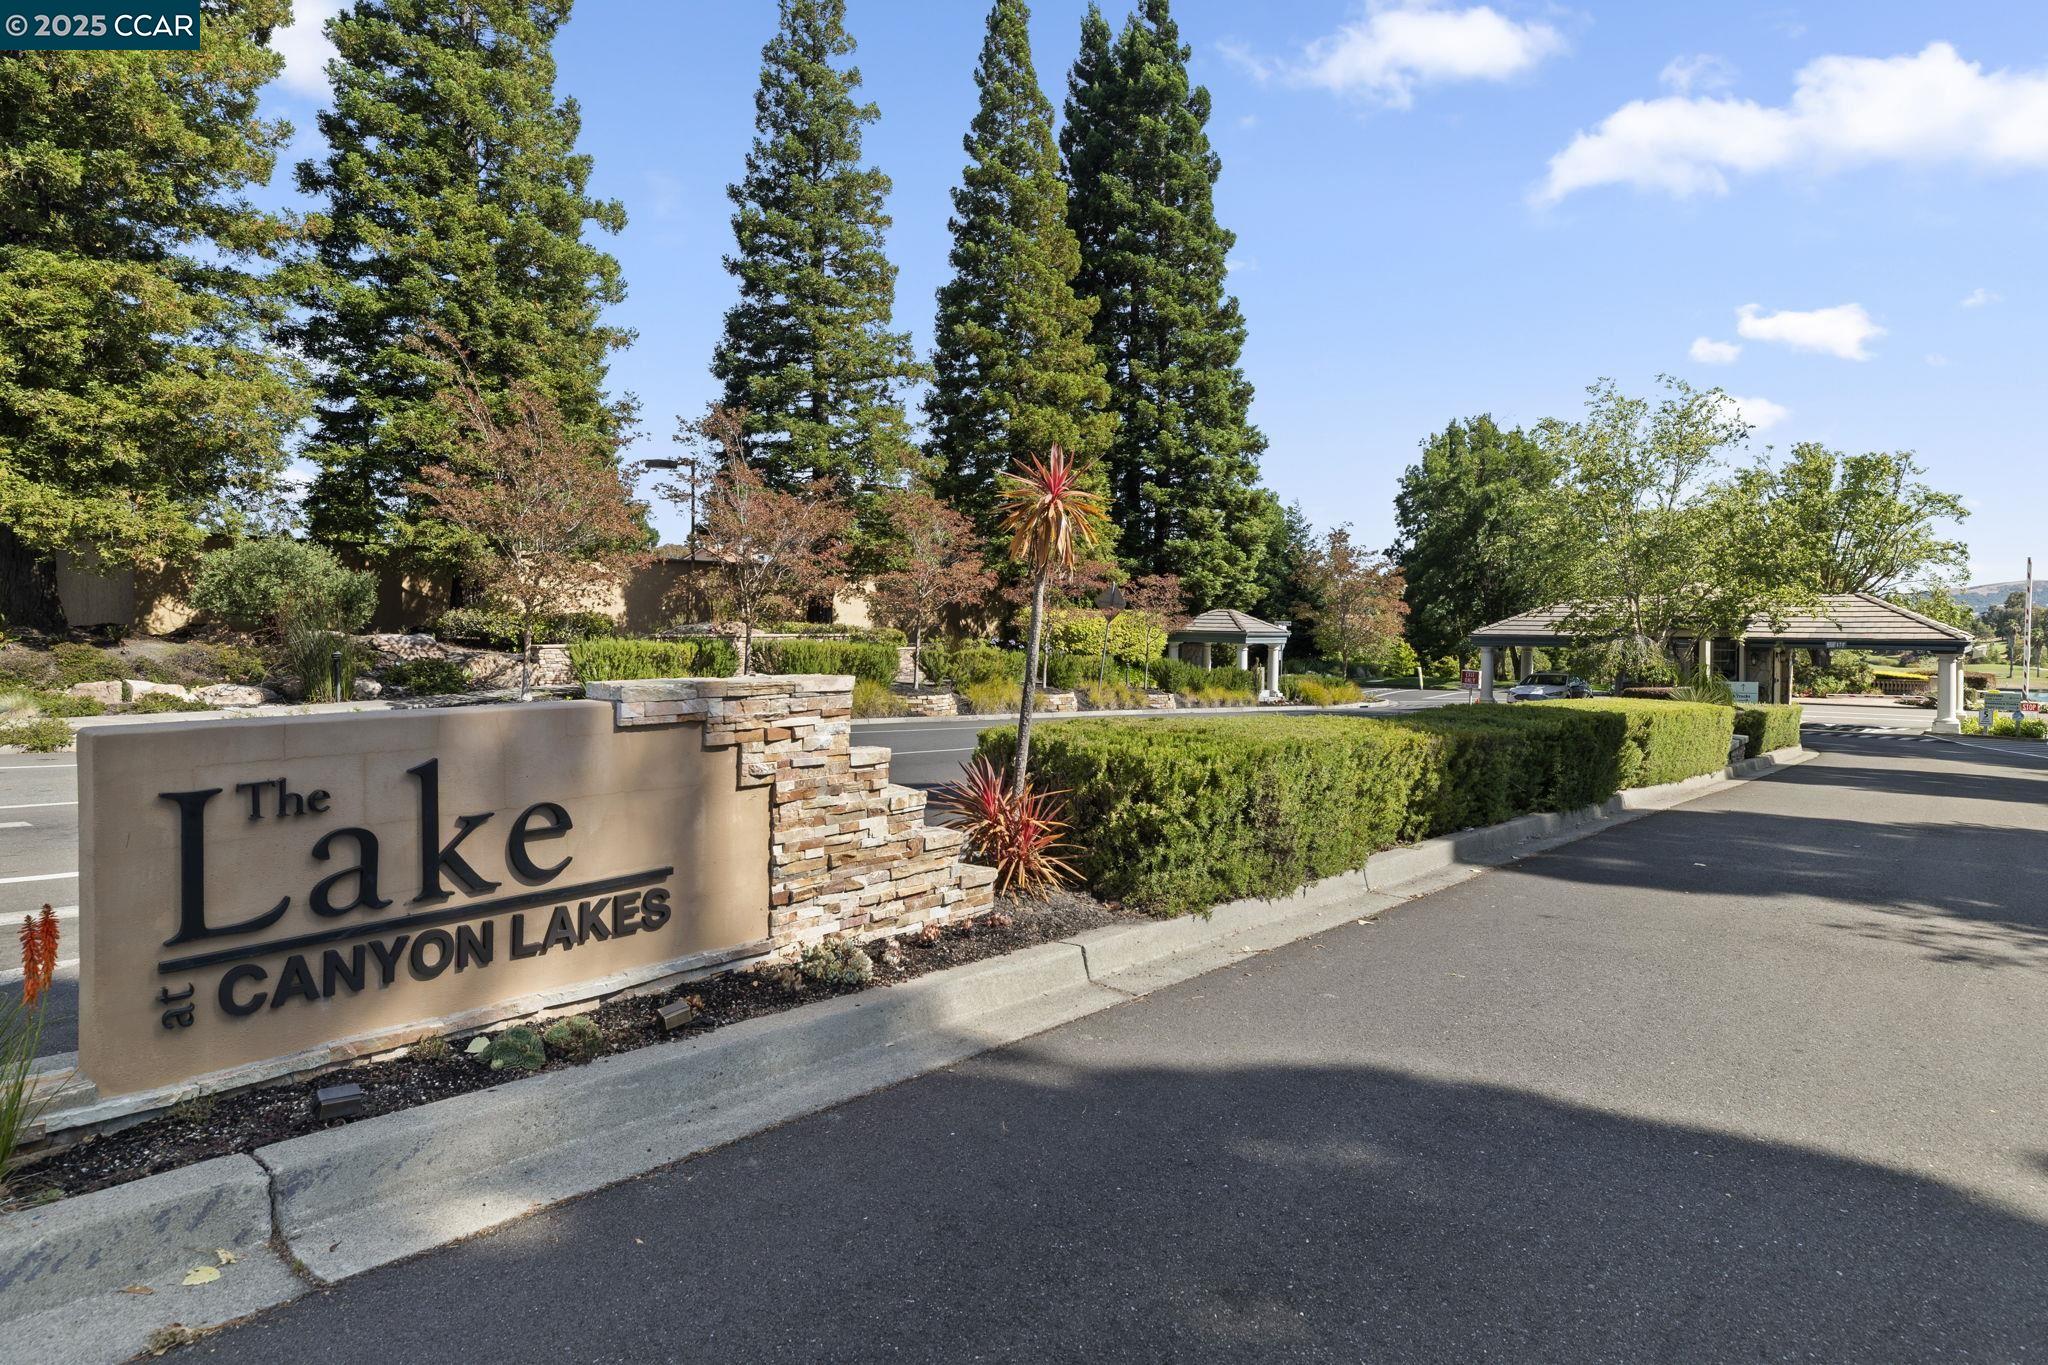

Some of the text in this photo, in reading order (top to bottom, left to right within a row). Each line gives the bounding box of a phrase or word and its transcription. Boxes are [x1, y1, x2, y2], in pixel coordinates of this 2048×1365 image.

[236, 776, 331, 821] The
[159, 757, 573, 947] Lake
[218, 888, 671, 1016] CANYON LAKES
[159, 982, 195, 1029] at
